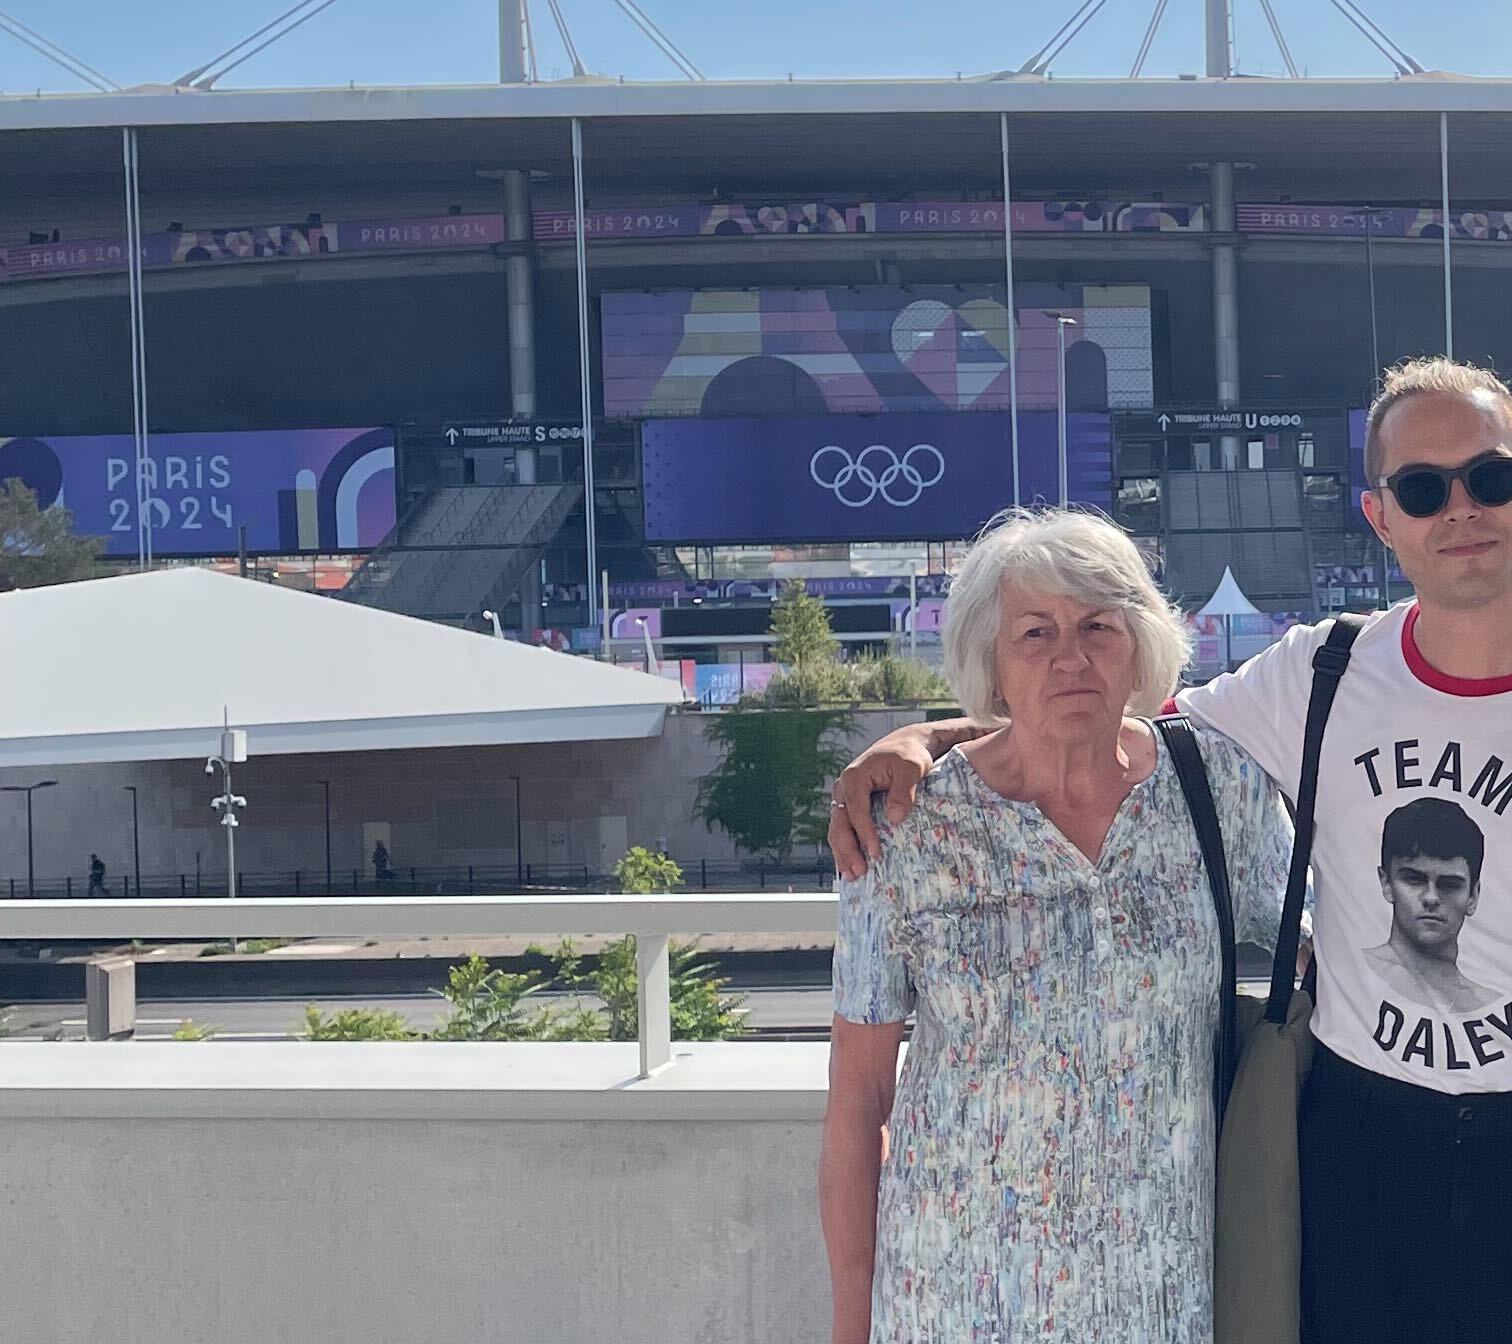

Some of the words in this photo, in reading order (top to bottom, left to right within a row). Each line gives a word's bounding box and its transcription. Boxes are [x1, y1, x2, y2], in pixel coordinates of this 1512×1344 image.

[900, 209, 961, 224] PARIS
[970, 209, 1025, 224] 204
[1261, 213, 1321, 228] PARIS
[361, 225, 421, 243] PARIS
[1245, 413, 1257, 429] U
[535, 425, 546, 442] S
[109, 496, 233, 531] 2024
[807, 581, 835, 592] ARIS
